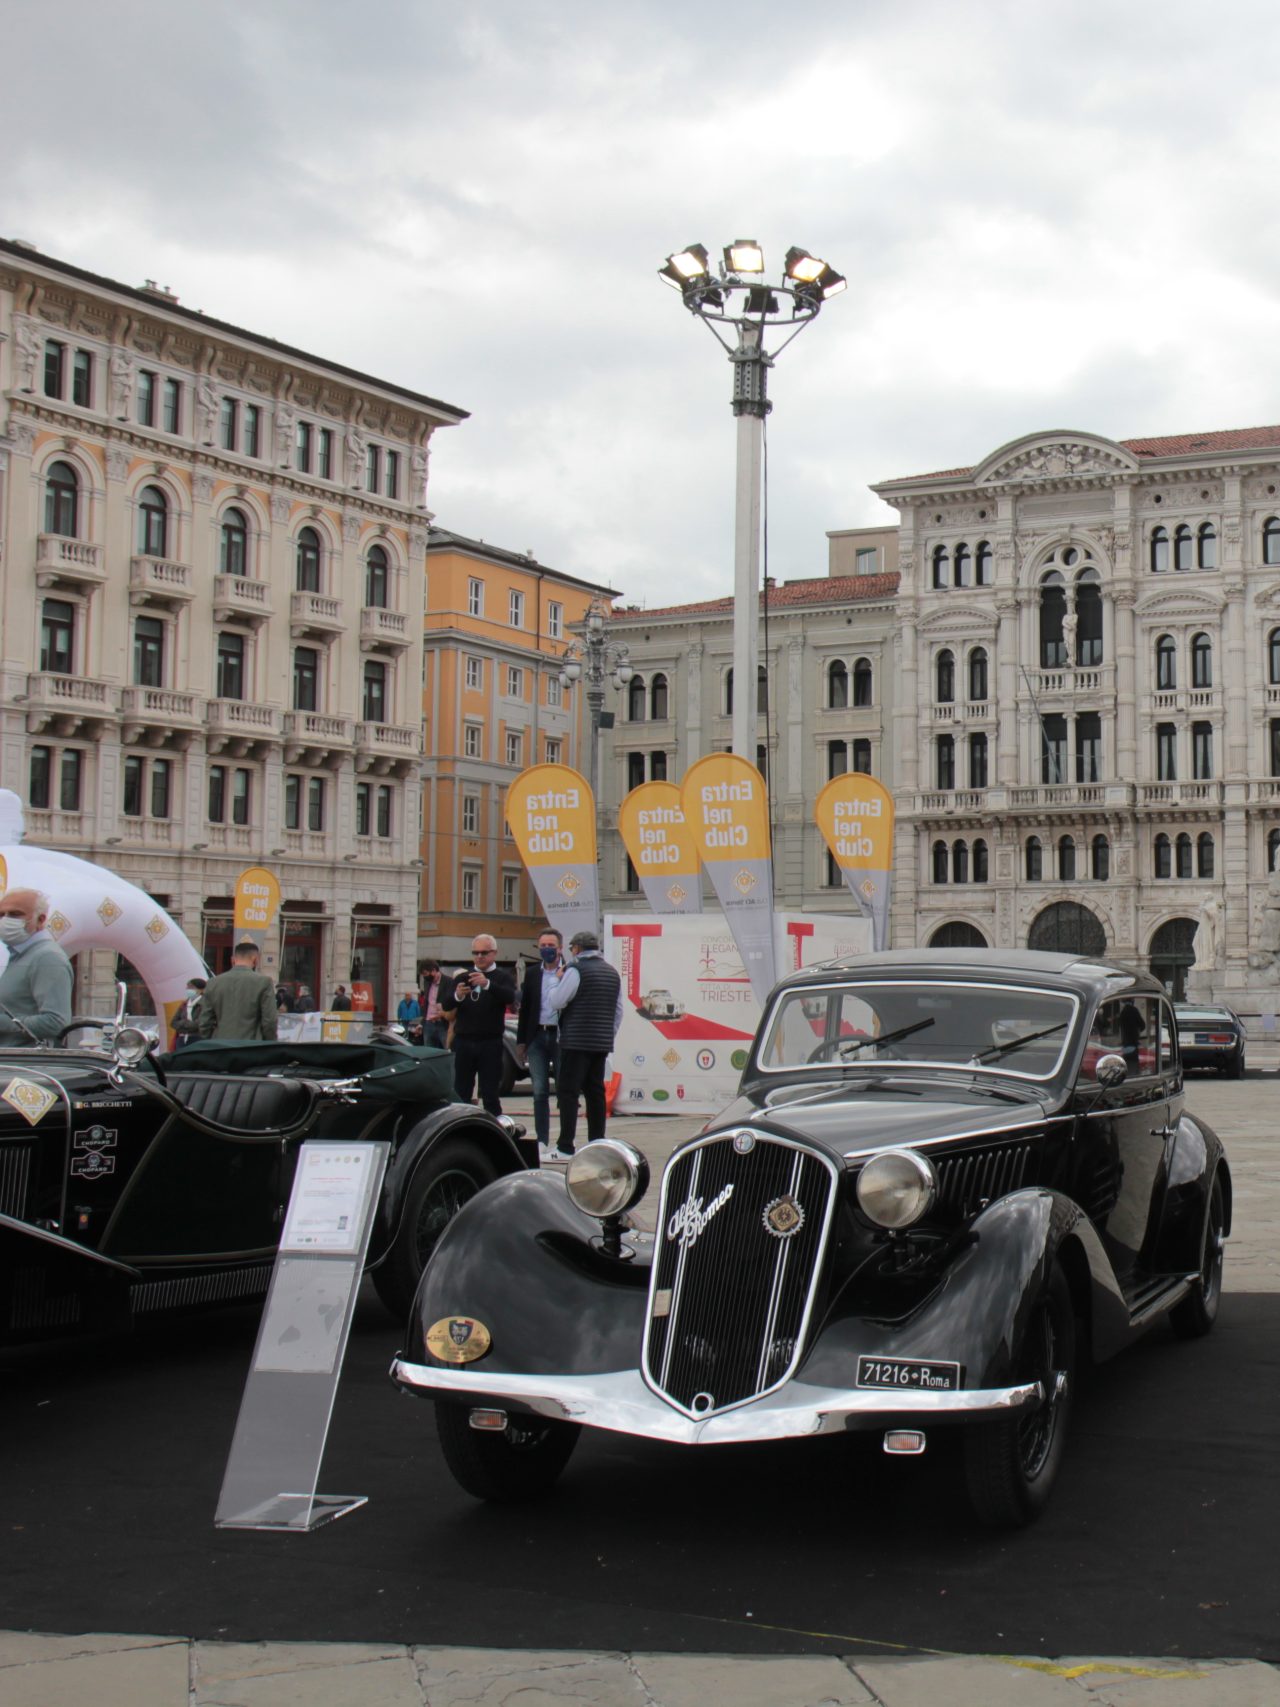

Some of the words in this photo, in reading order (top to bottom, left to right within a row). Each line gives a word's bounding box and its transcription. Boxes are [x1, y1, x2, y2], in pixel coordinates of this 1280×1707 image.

[243, 881, 270, 896] Entra
[252, 896, 268, 908] nel
[244, 908, 267, 921] Club
[700, 990, 752, 1003] TRIESTE
[863, 1363, 910, 1385] 71216
[919, 1367, 951, 1389] Roma
